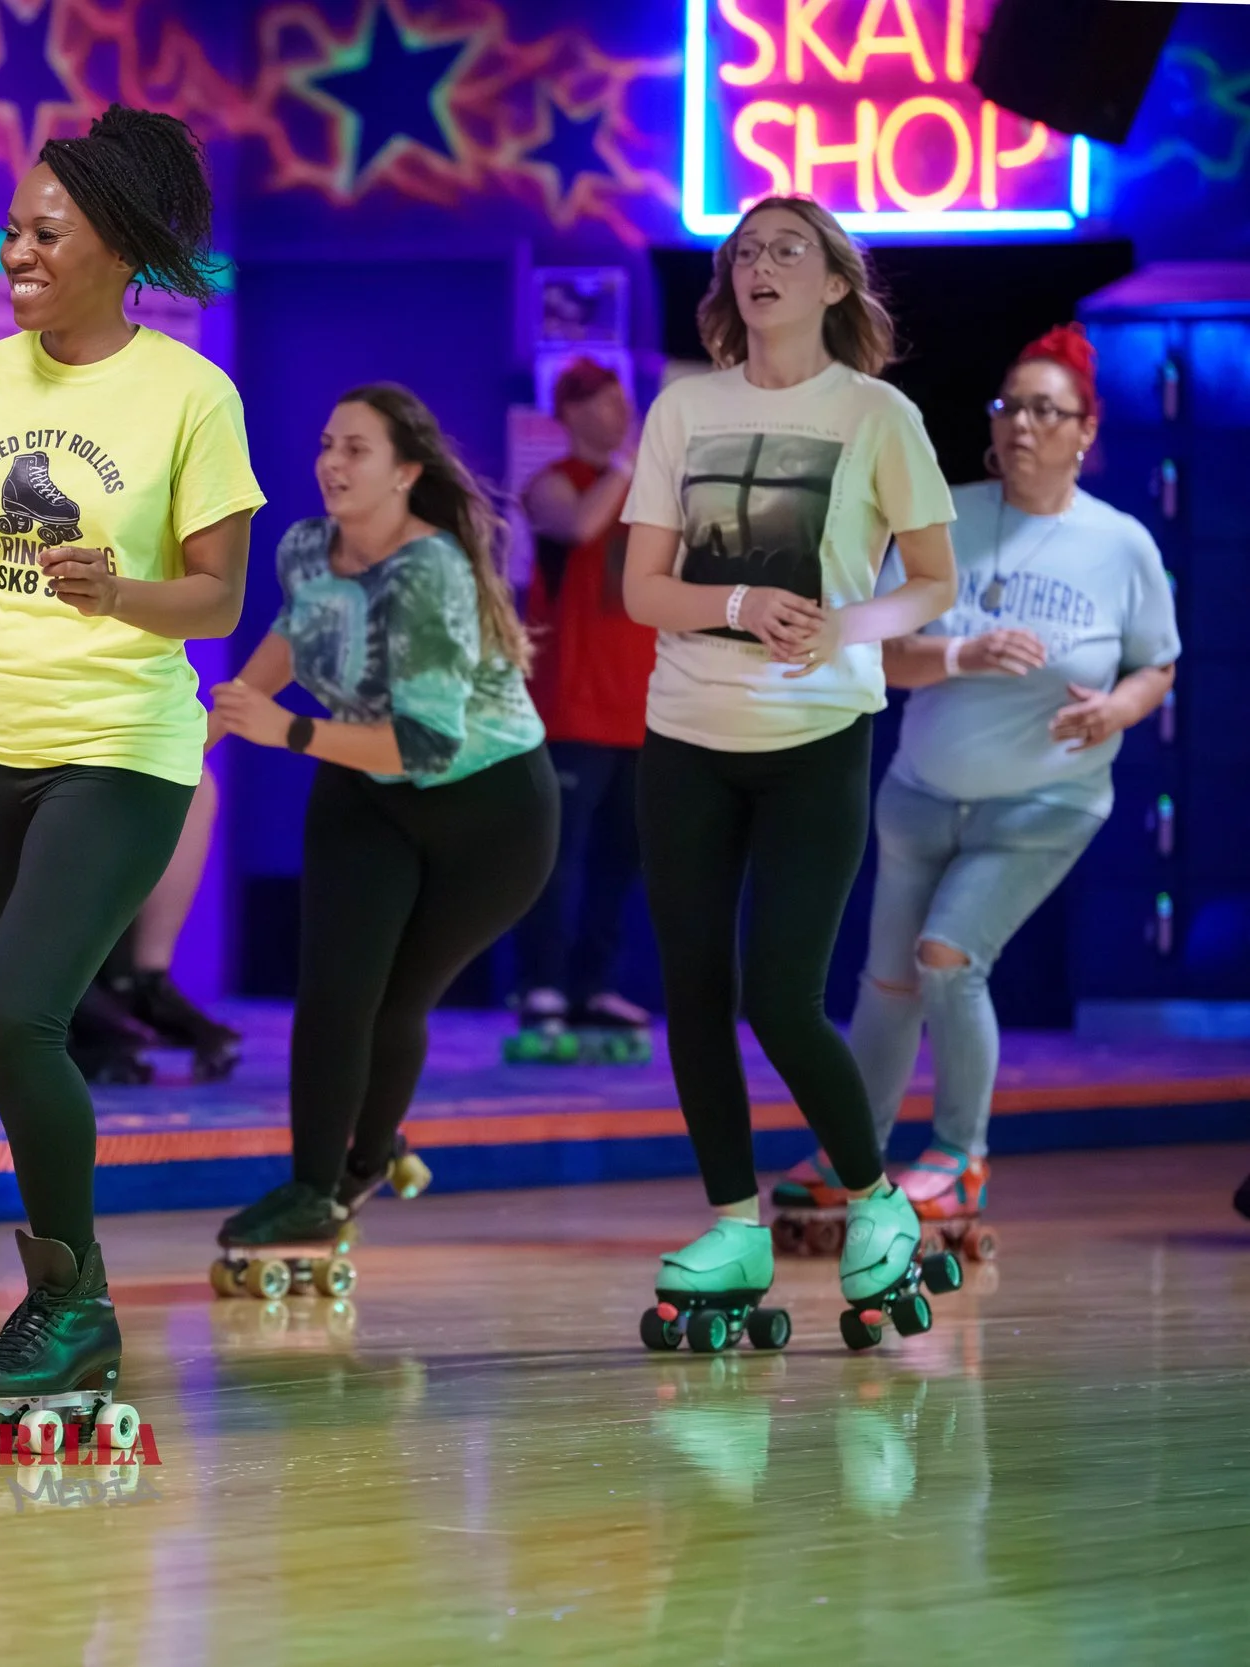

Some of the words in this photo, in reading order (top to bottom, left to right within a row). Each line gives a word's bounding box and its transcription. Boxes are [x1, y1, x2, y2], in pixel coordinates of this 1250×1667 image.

[732, 96, 1049, 214] SHOP
[25, 429, 68, 449] CITY
[68, 433, 125, 495] ROLLERS
